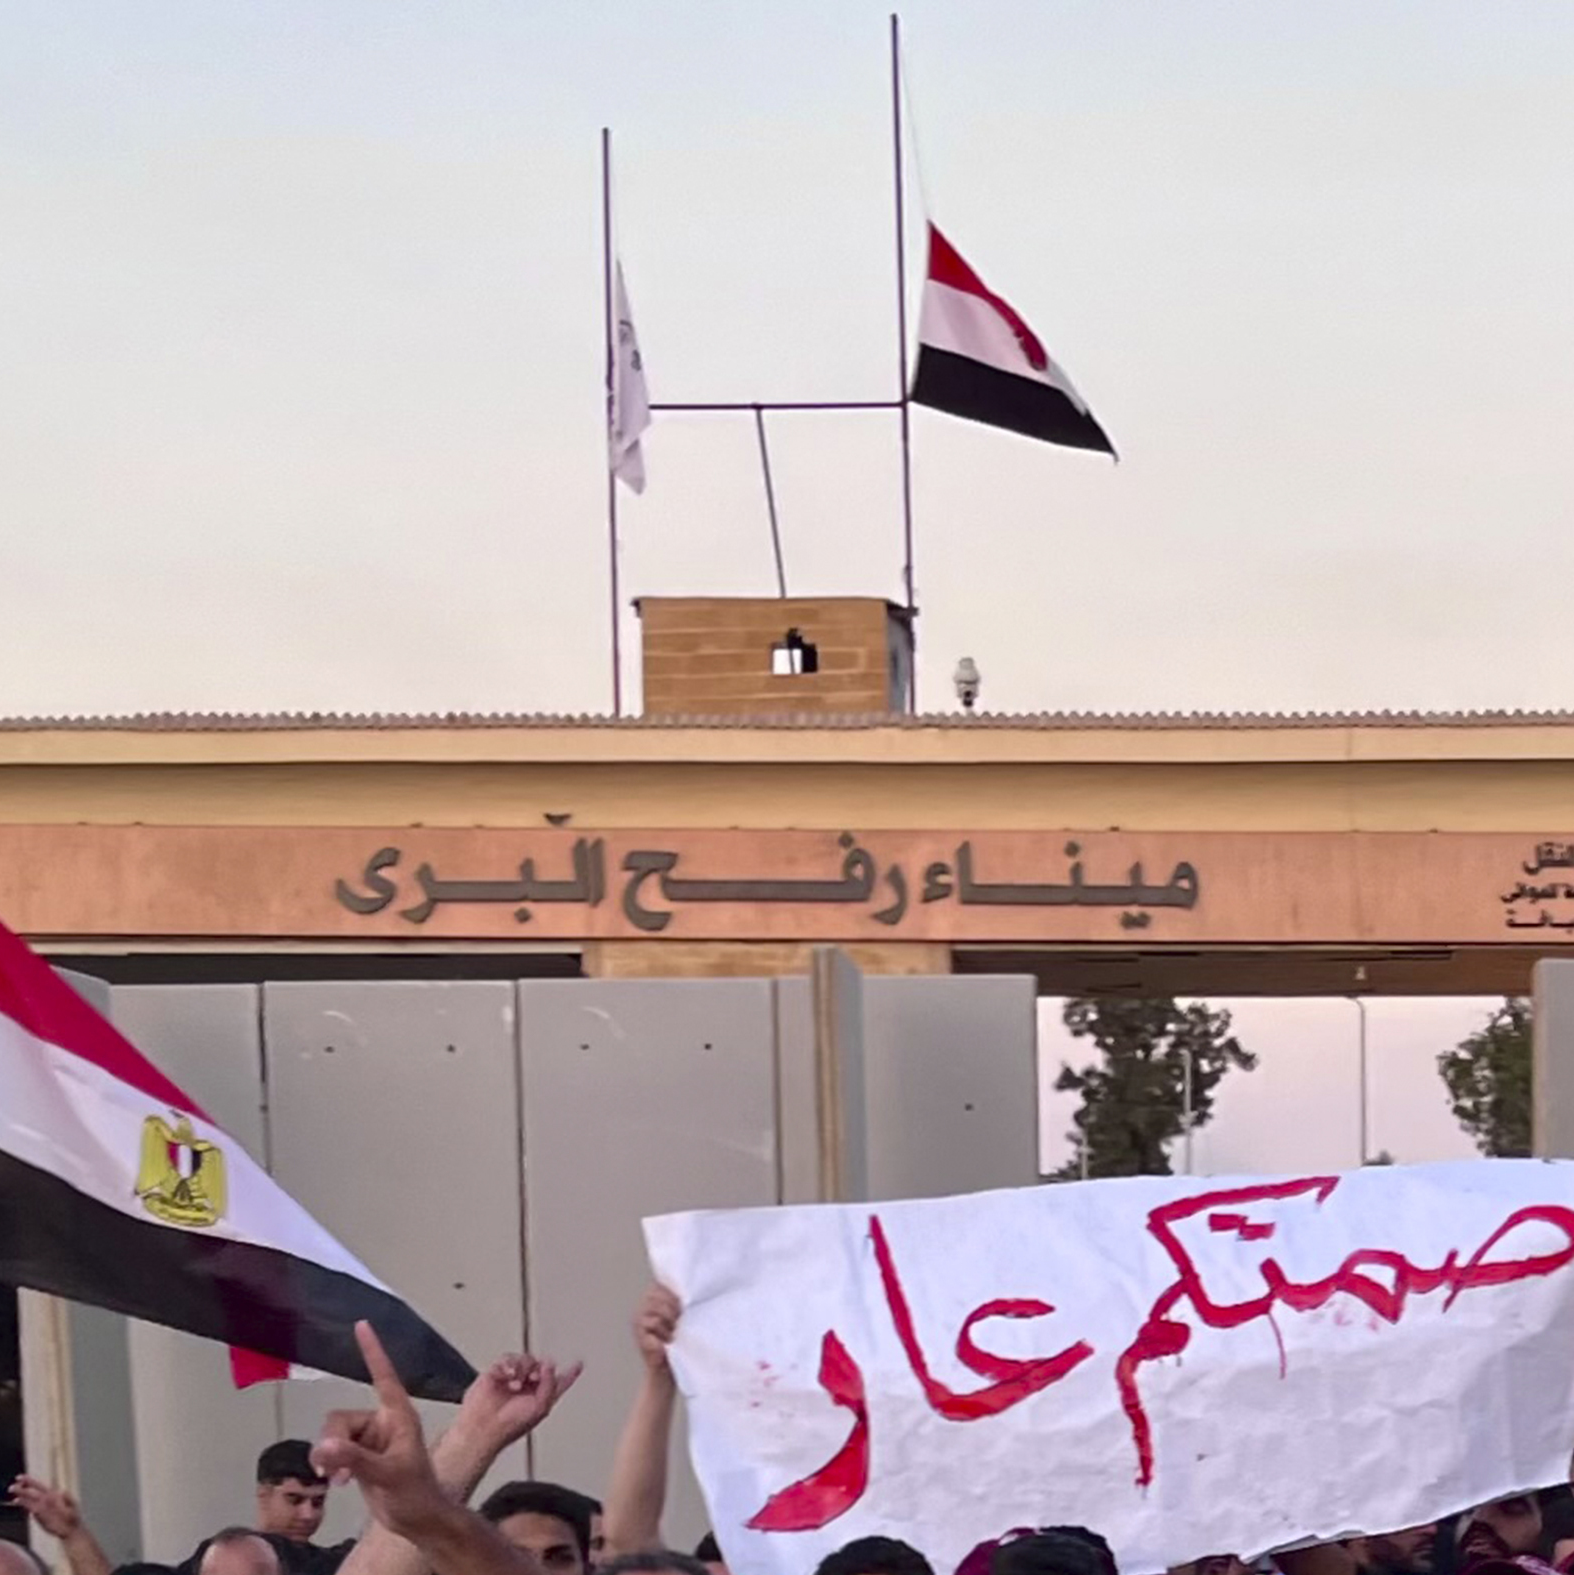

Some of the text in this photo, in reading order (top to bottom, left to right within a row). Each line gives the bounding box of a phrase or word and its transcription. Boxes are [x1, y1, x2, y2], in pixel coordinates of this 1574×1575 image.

[620, 831, 908, 931] رفح
[920, 840, 1200, 930] ميناء
[746, 1215, 1095, 1532] عار
